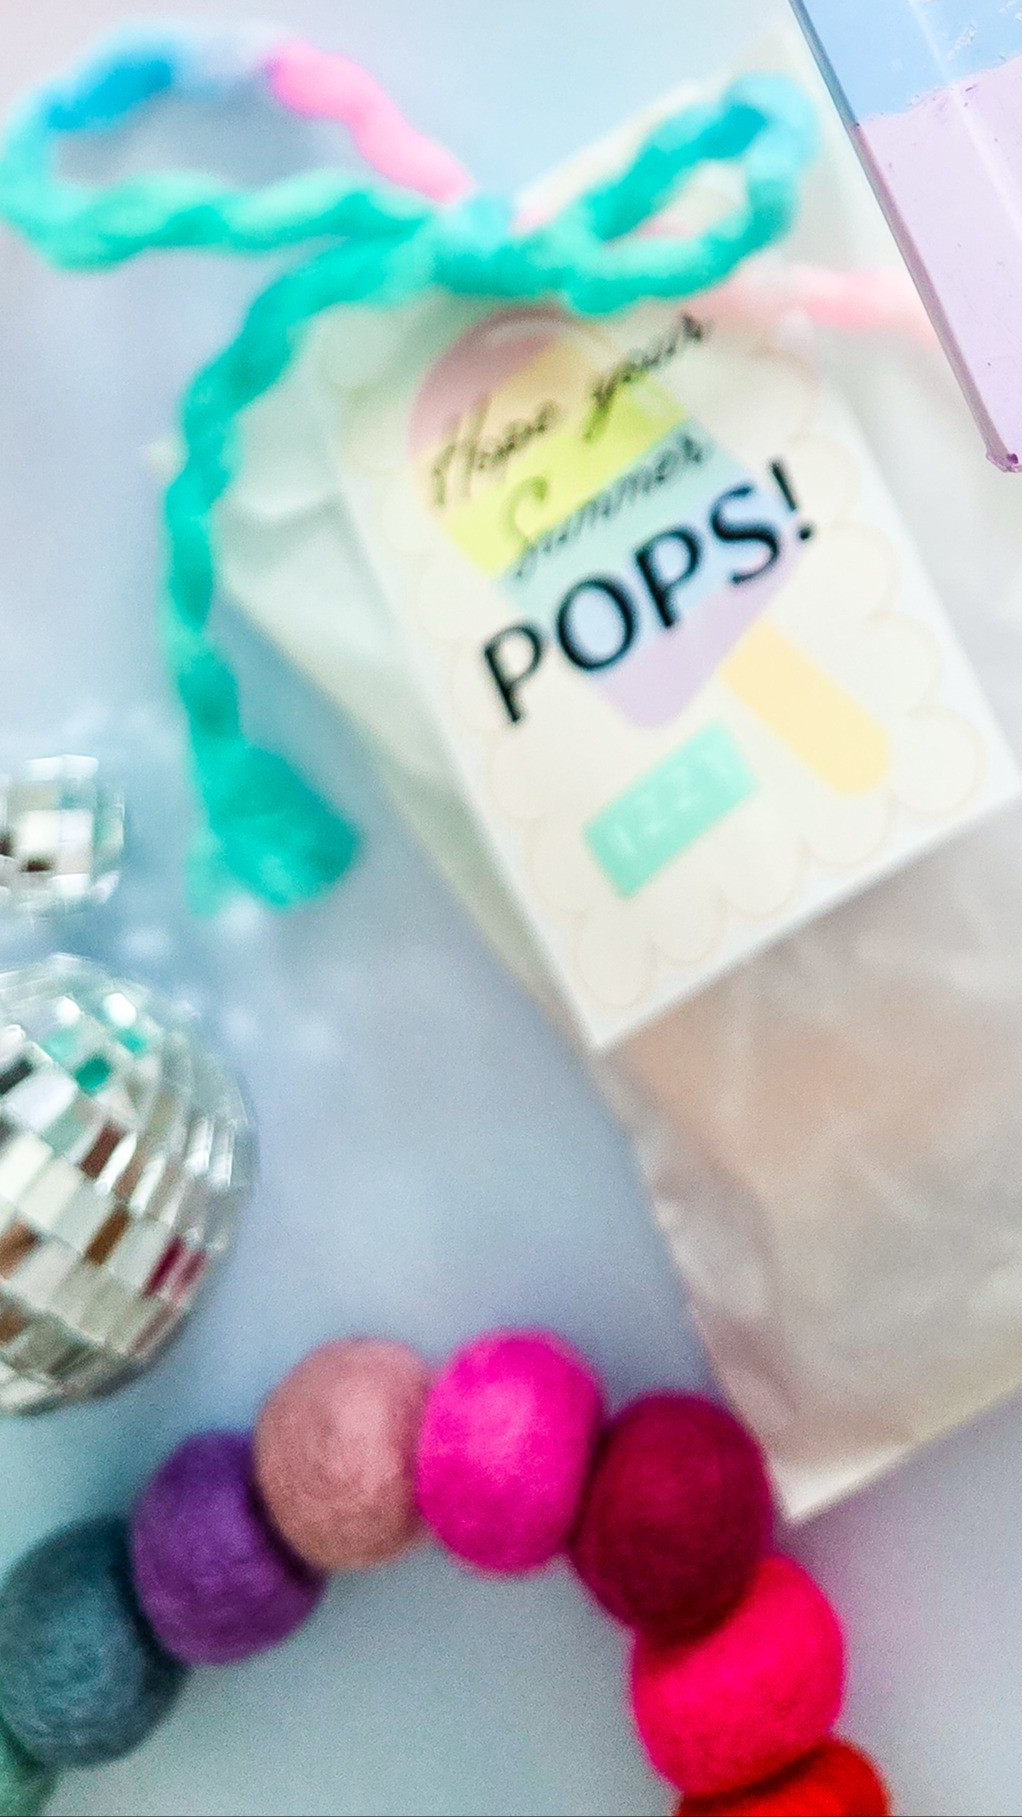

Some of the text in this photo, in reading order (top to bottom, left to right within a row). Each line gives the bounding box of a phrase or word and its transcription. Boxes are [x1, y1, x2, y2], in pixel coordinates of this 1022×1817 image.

[429, 308, 714, 512] Hope your
[502, 426, 714, 584] Summer
[480, 456, 817, 726] POPS!
